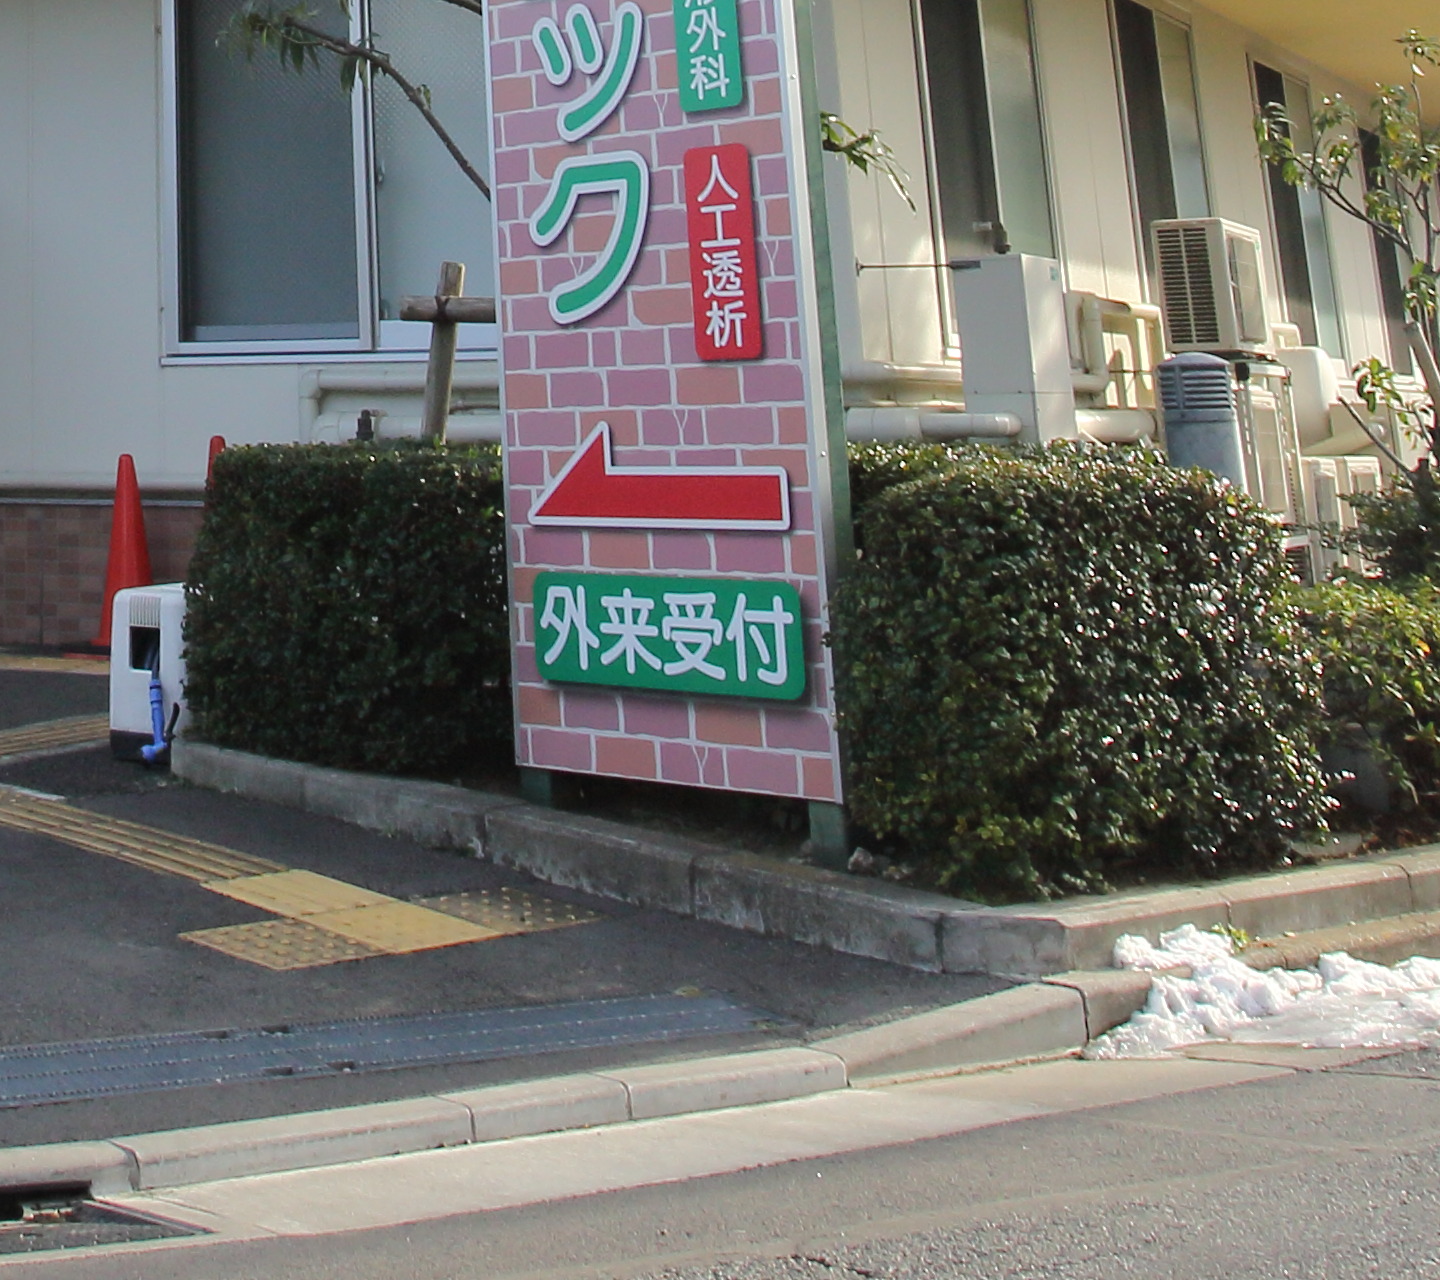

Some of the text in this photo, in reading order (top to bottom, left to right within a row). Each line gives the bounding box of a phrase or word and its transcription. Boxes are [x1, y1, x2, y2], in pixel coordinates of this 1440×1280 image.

[696, 151, 749, 349] 人工透析
[538, 584, 796, 688] 外来受付
